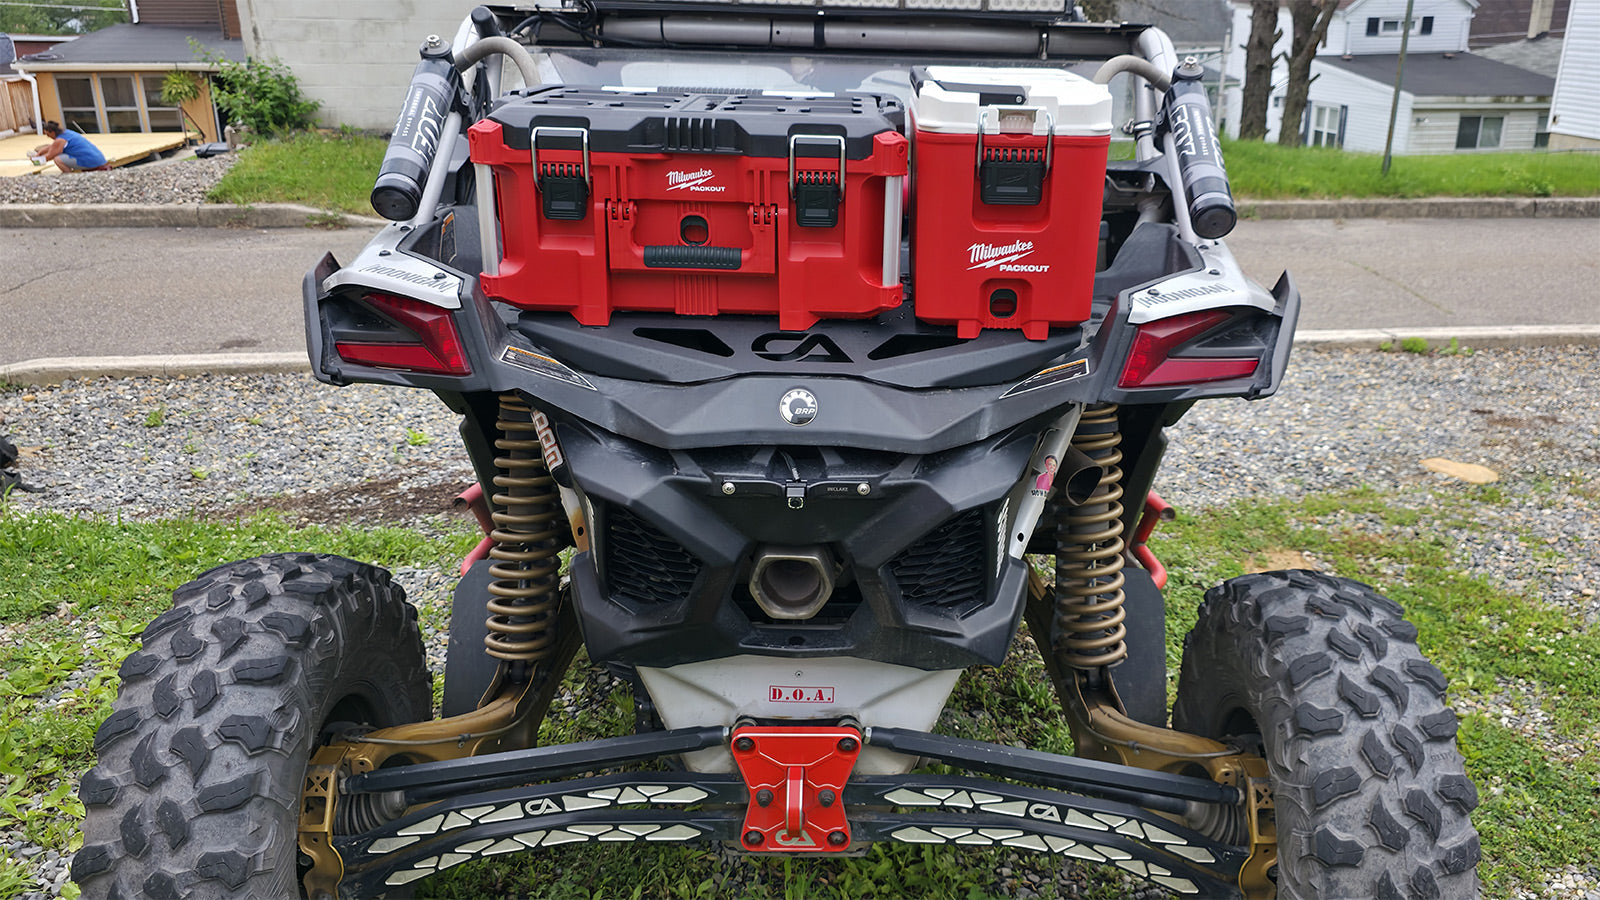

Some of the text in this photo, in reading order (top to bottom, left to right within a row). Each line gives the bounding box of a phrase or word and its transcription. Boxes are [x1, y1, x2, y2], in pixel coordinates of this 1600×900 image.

[666, 168, 713, 185] Milwaukee
[967, 240, 1034, 263] Milwaukee
[999, 264, 1050, 273] PACKOUT
[794, 407, 816, 415] BRP
[771, 687, 832, 701] D.O.A.
